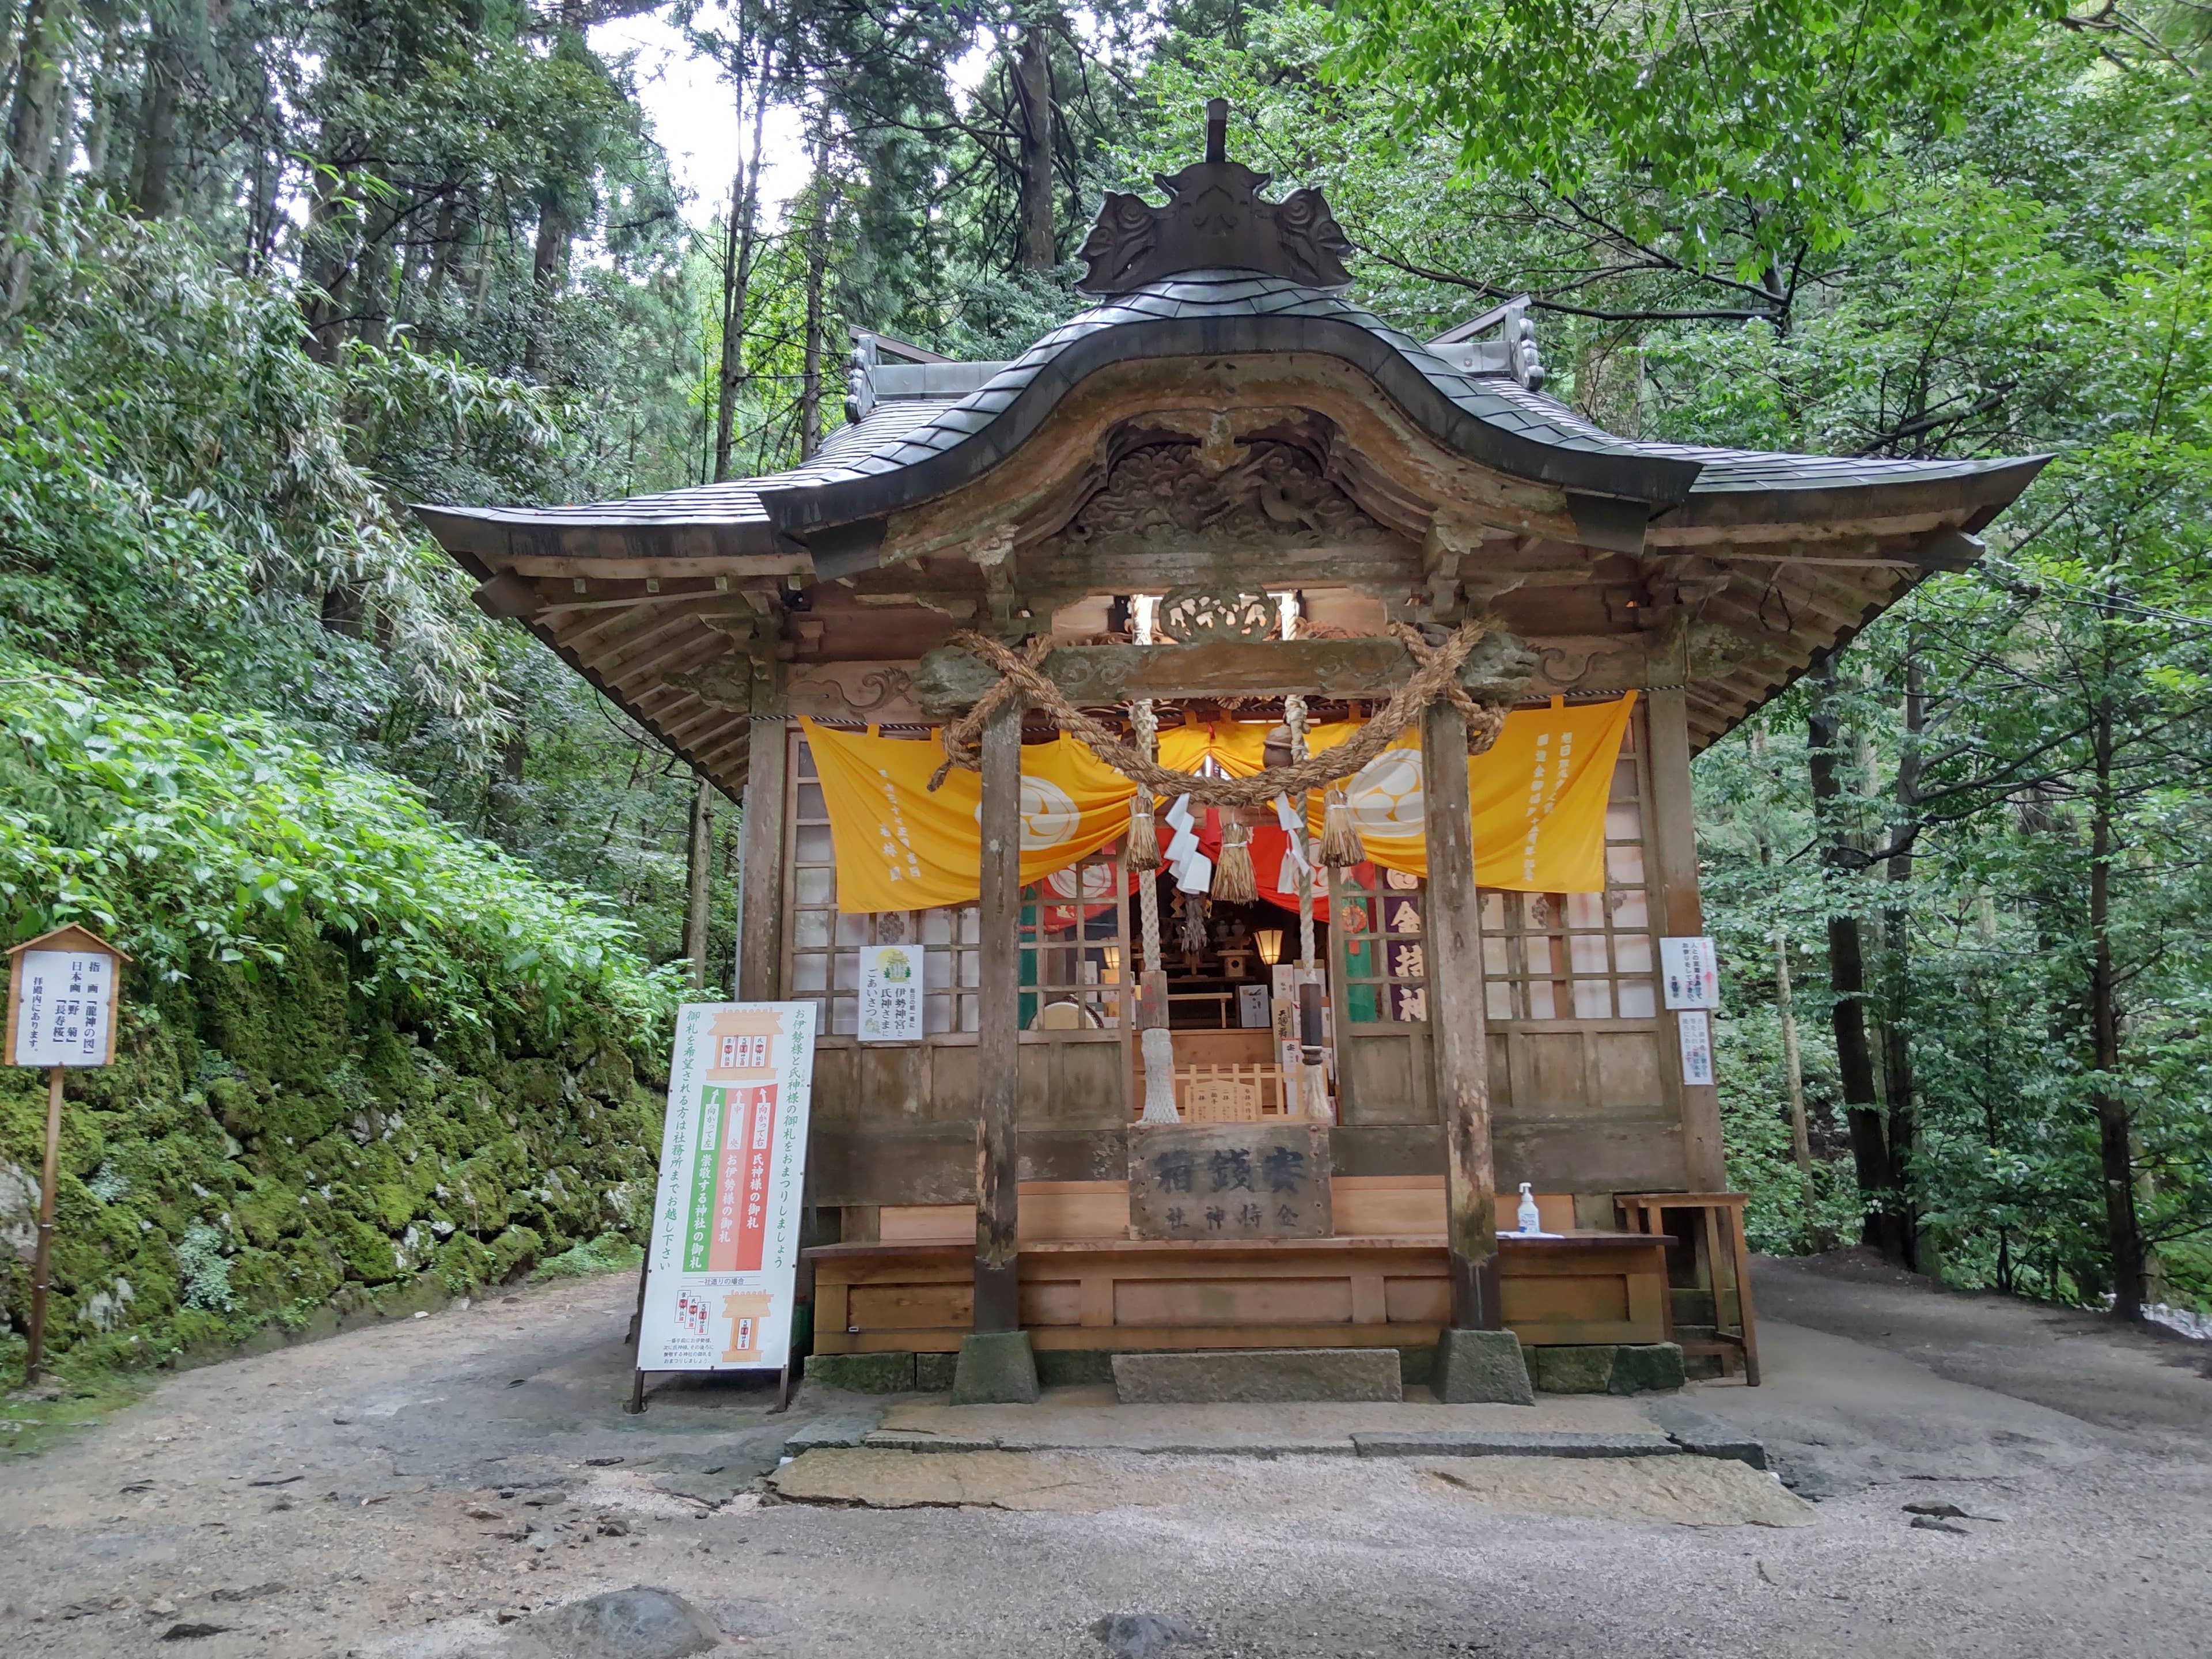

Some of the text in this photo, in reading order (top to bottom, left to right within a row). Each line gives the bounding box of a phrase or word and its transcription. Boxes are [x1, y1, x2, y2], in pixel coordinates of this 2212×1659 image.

[881, 988, 892, 1037] 氏神さまに
[895, 987, 907, 1037] 伊勢神宮と
[703, 1106, 716, 1148] 向かって左
[755, 1105, 768, 1147] 向かって右
[690, 1153, 712, 1268] 崇敬する神社の御札
[719, 1154, 737, 1243] お伊勢様の御札
[747, 1153, 764, 1229] 氏神様の御札
[698, 1277, 744, 1285] 一社造りの場合
